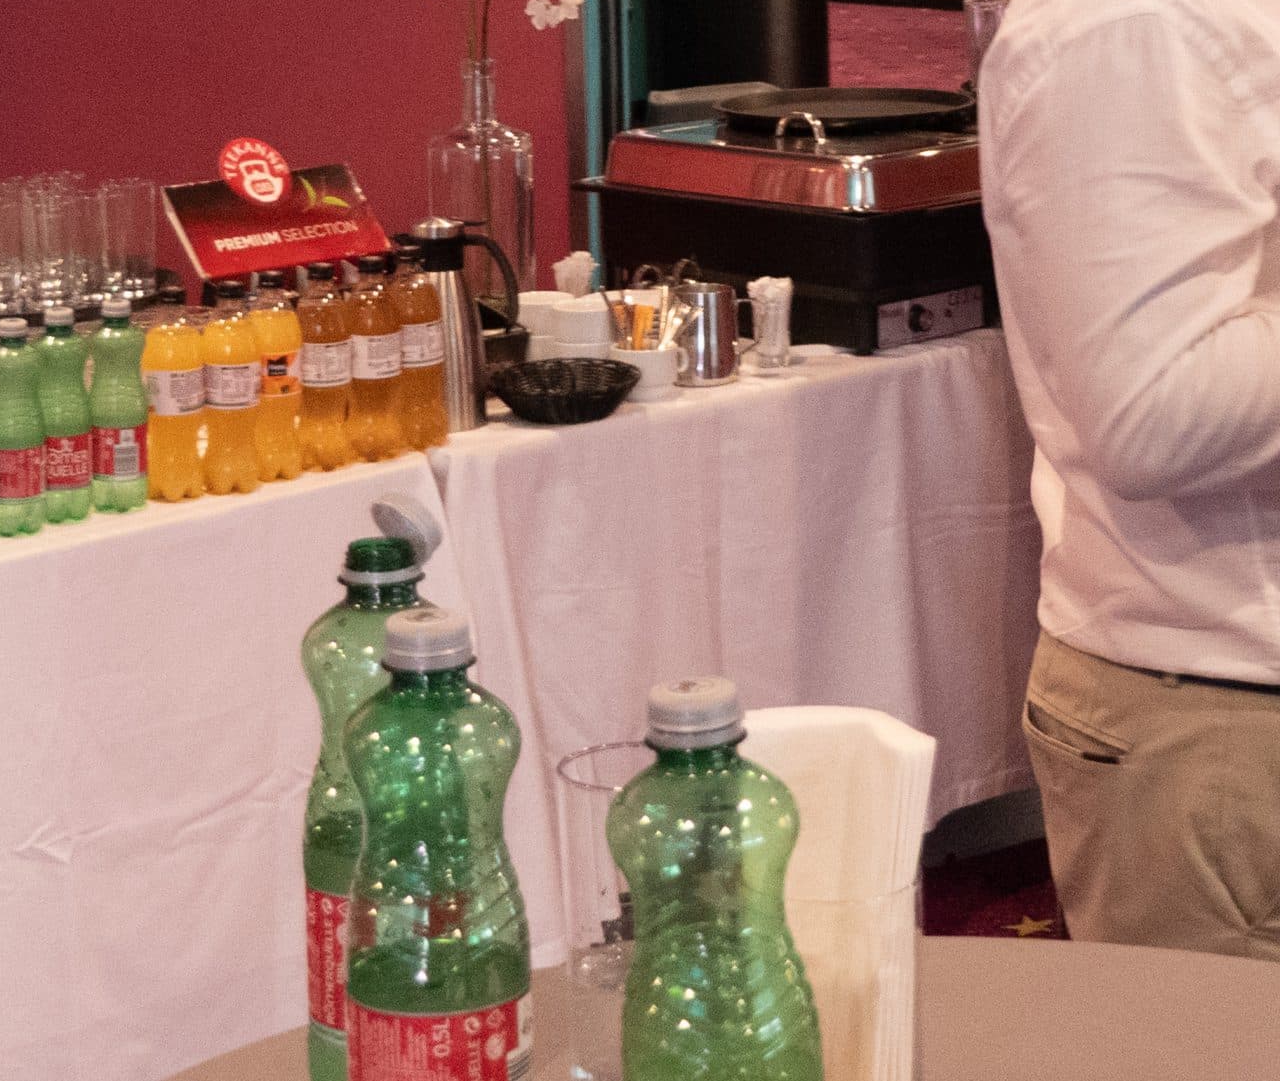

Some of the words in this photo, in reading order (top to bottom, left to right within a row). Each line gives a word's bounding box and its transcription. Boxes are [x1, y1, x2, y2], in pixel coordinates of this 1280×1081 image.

[223, 140, 289, 180] TEEKANNE
[214, 231, 282, 253] PREMIUM
[281, 220, 359, 243] SELECTION
